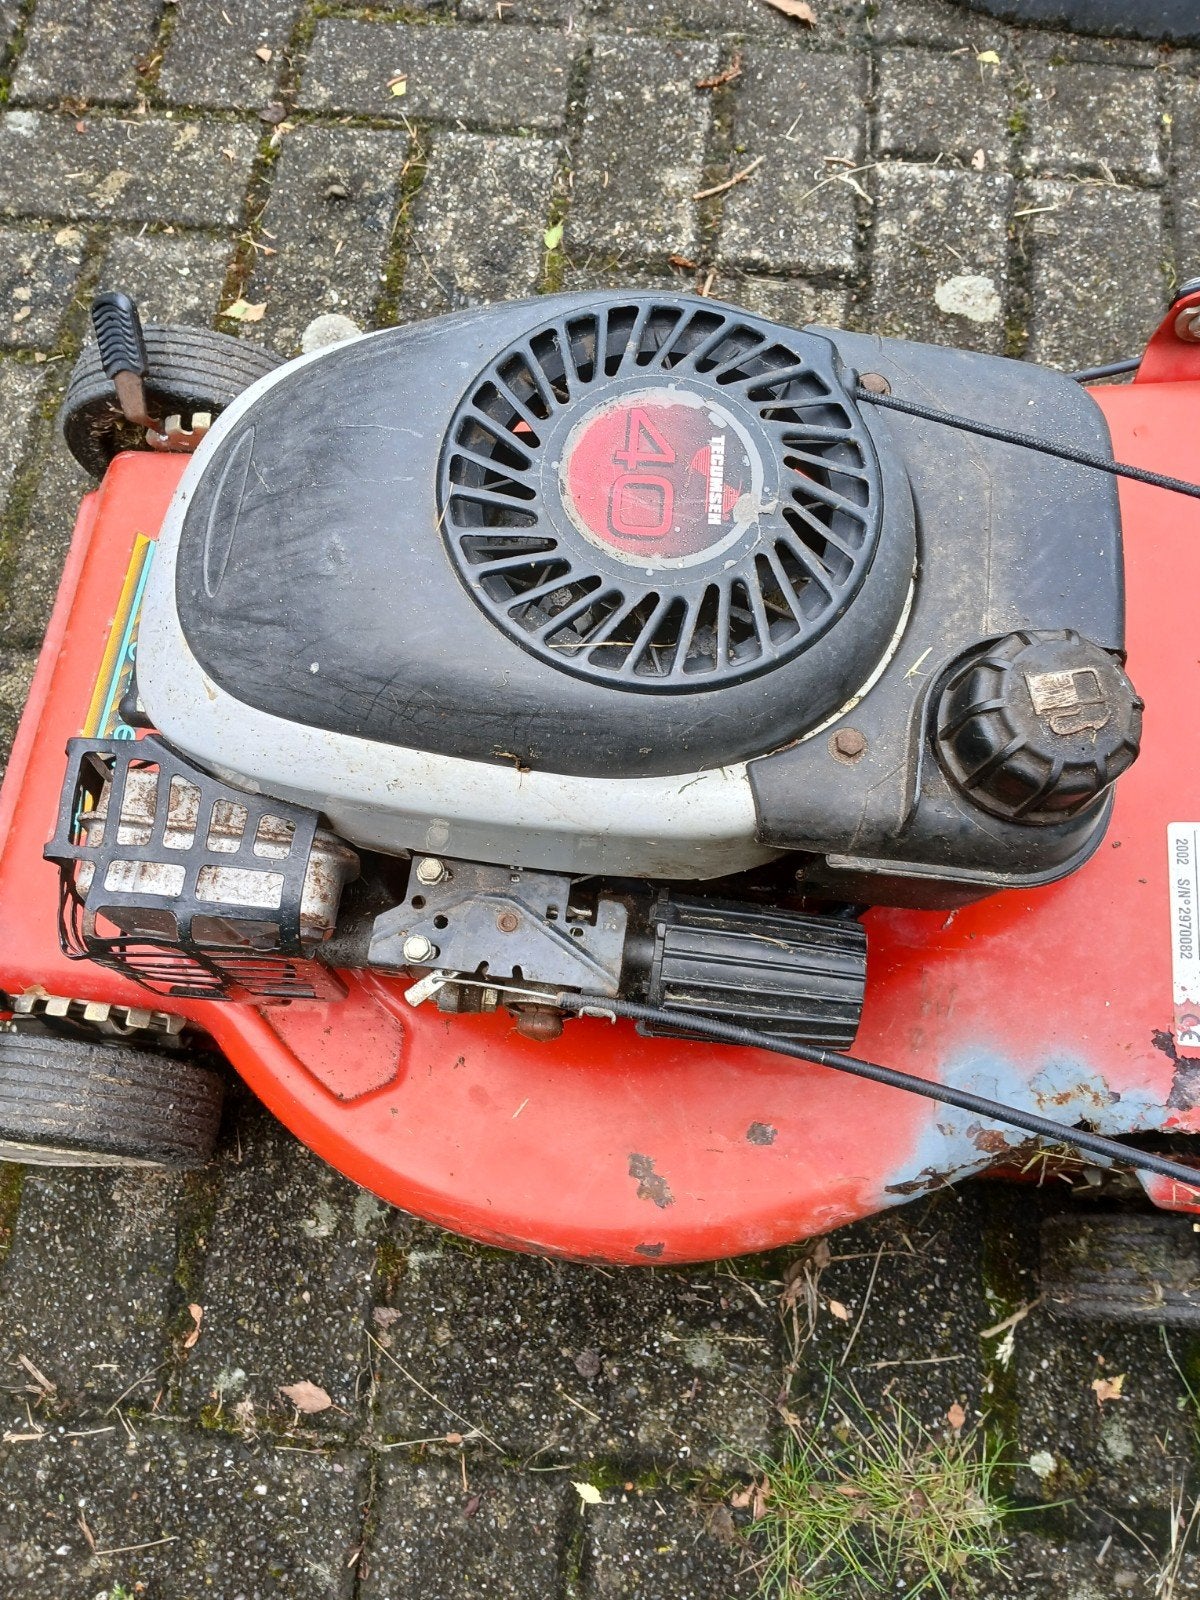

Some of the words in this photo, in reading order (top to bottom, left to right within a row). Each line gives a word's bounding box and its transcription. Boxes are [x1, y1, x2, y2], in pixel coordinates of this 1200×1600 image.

[607, 408, 676, 539] 40
[708, 434, 726, 525] TECUMSEH
[1176, 838, 1188, 865] 2002
